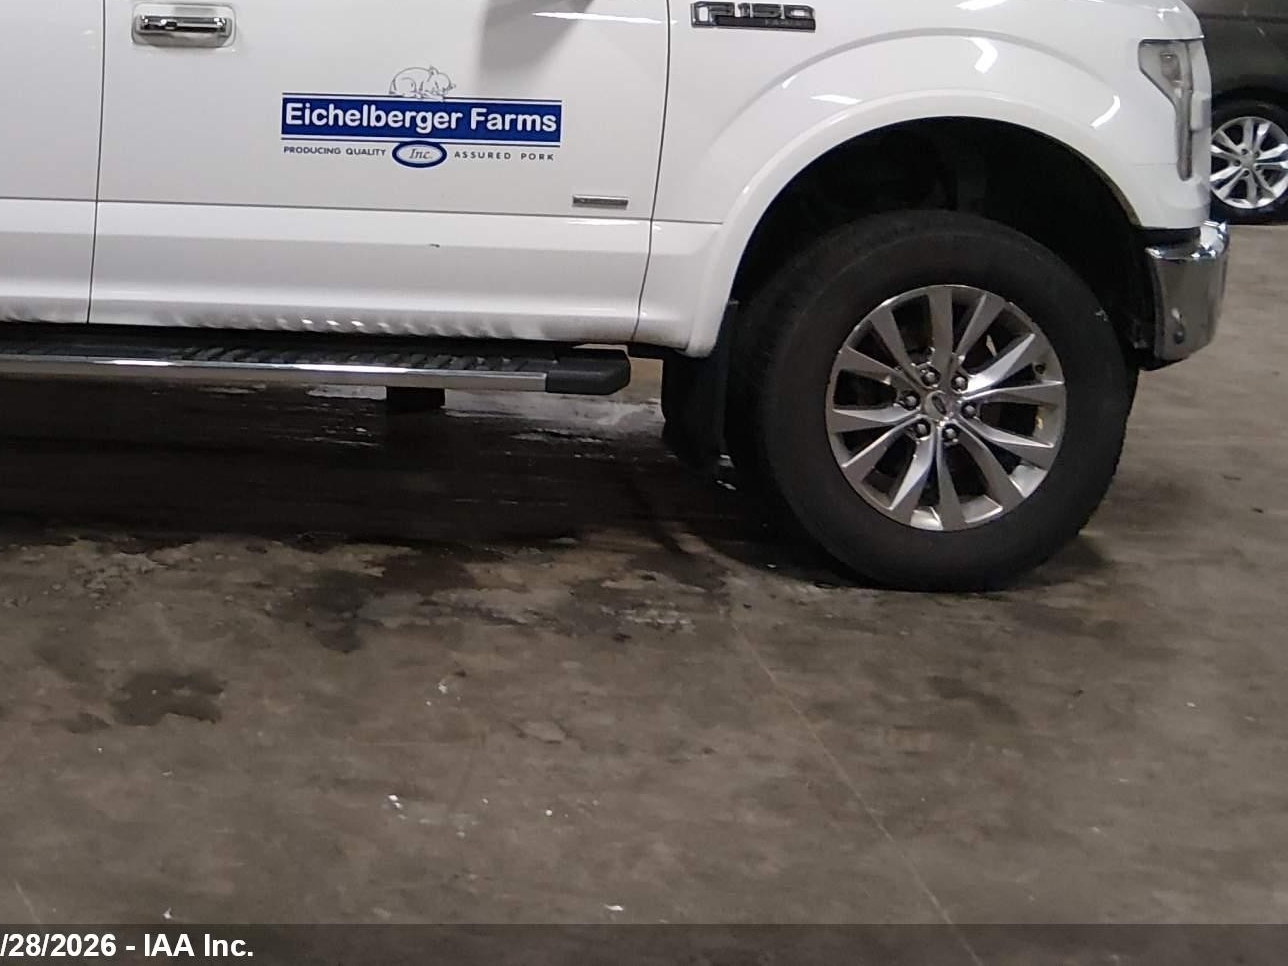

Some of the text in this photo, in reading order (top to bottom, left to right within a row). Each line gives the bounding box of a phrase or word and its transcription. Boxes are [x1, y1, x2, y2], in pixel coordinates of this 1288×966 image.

[285, 103, 557, 134] Eichelberger Farms
[283, 145, 555, 161] PRODUCING QUALITY ASSURED PORK
[408, 147, 434, 160] Inc.
